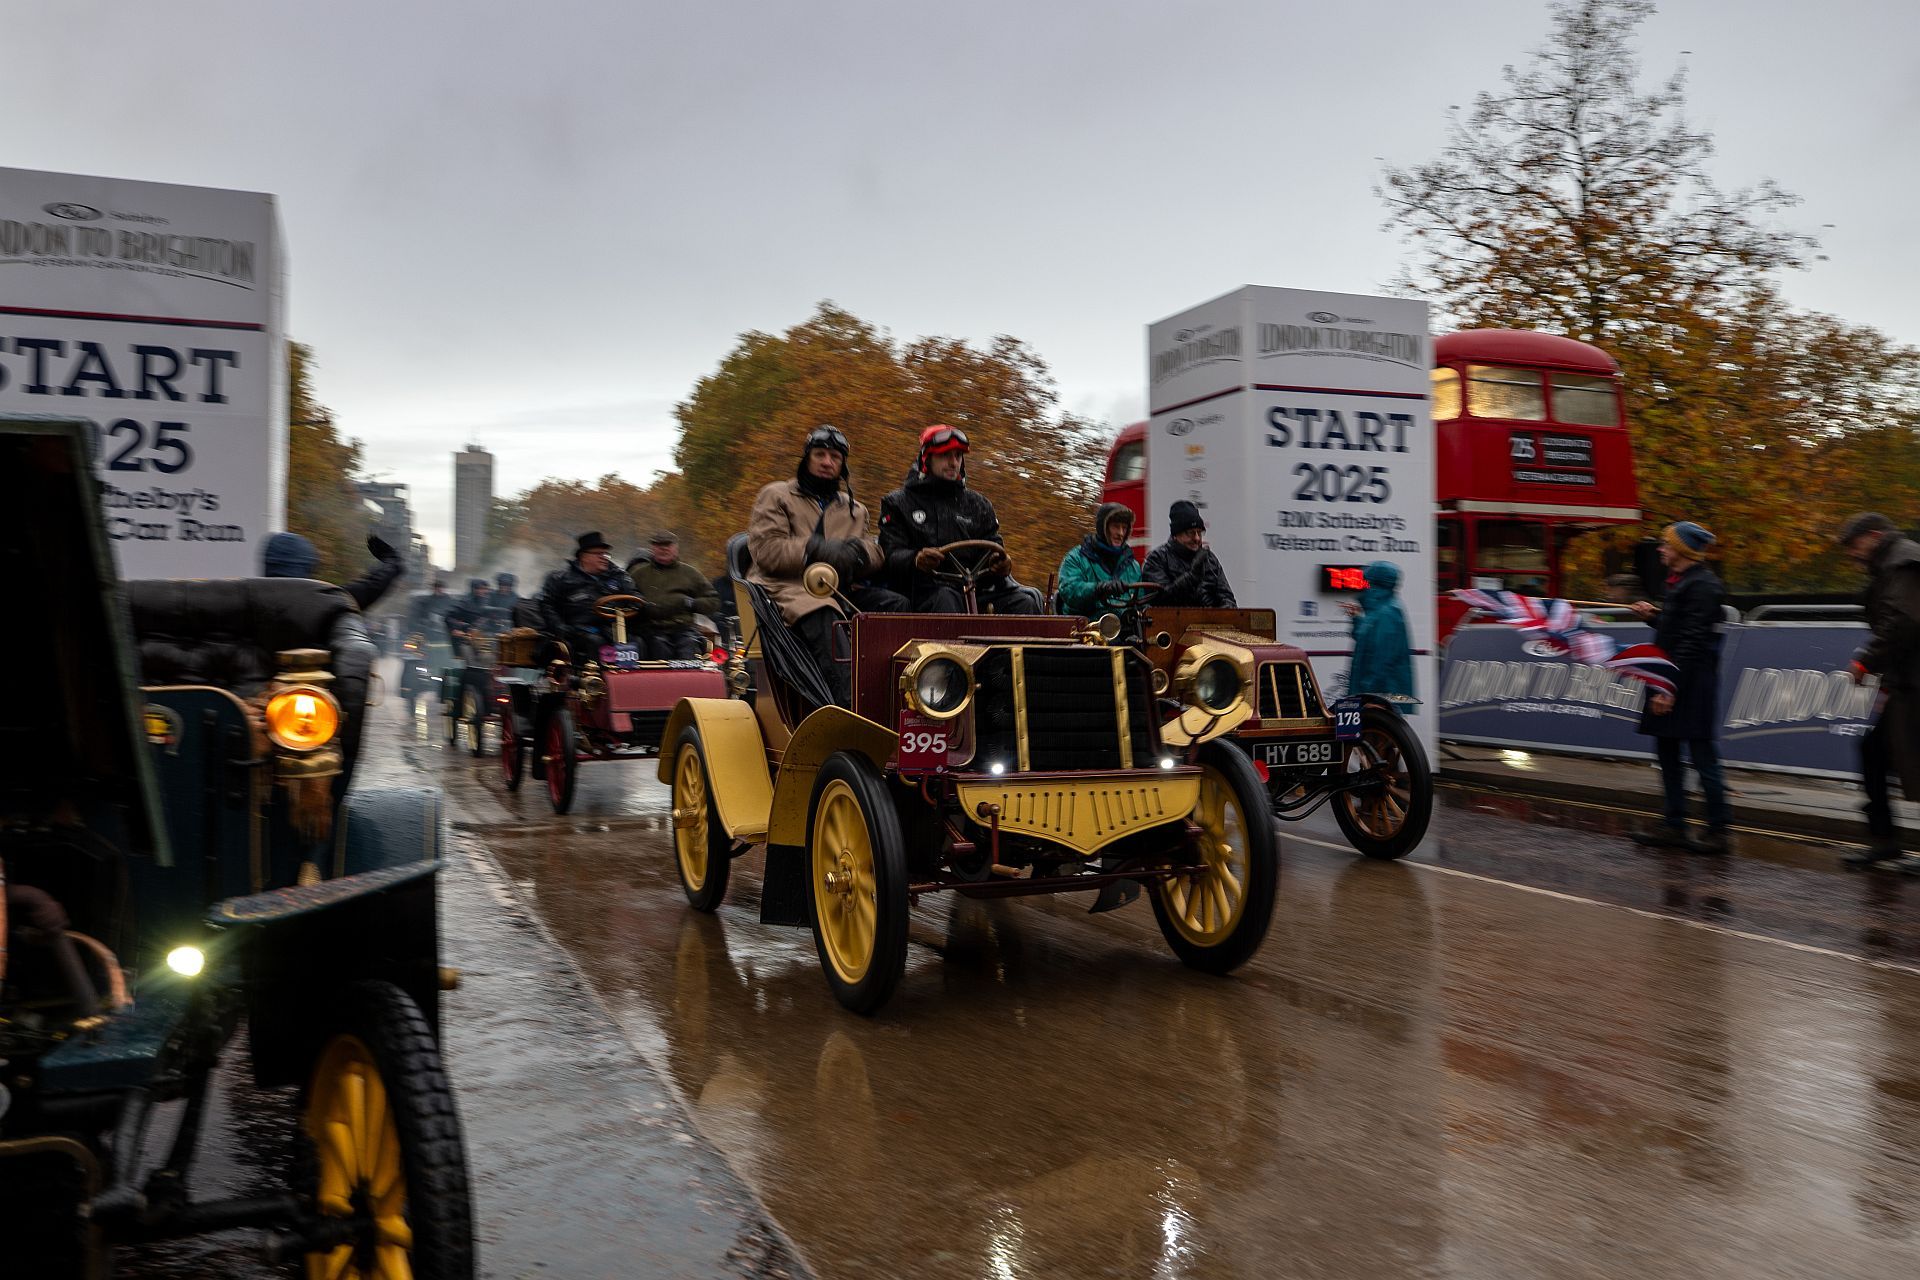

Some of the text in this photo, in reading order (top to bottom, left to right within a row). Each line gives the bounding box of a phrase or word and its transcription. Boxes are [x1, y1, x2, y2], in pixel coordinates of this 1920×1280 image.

[0, 336, 241, 404] TART
[1264, 405, 1417, 453] START
[104, 417, 195, 474] 25
[1289, 462, 1393, 505] 2025
[176, 518, 246, 543] Run
[1262, 532, 1342, 551] Veteran
[1380, 535, 1421, 553] Run
[1337, 711, 1361, 726] 178
[901, 732, 947, 754] 395
[1266, 743, 1332, 764] HY 689
